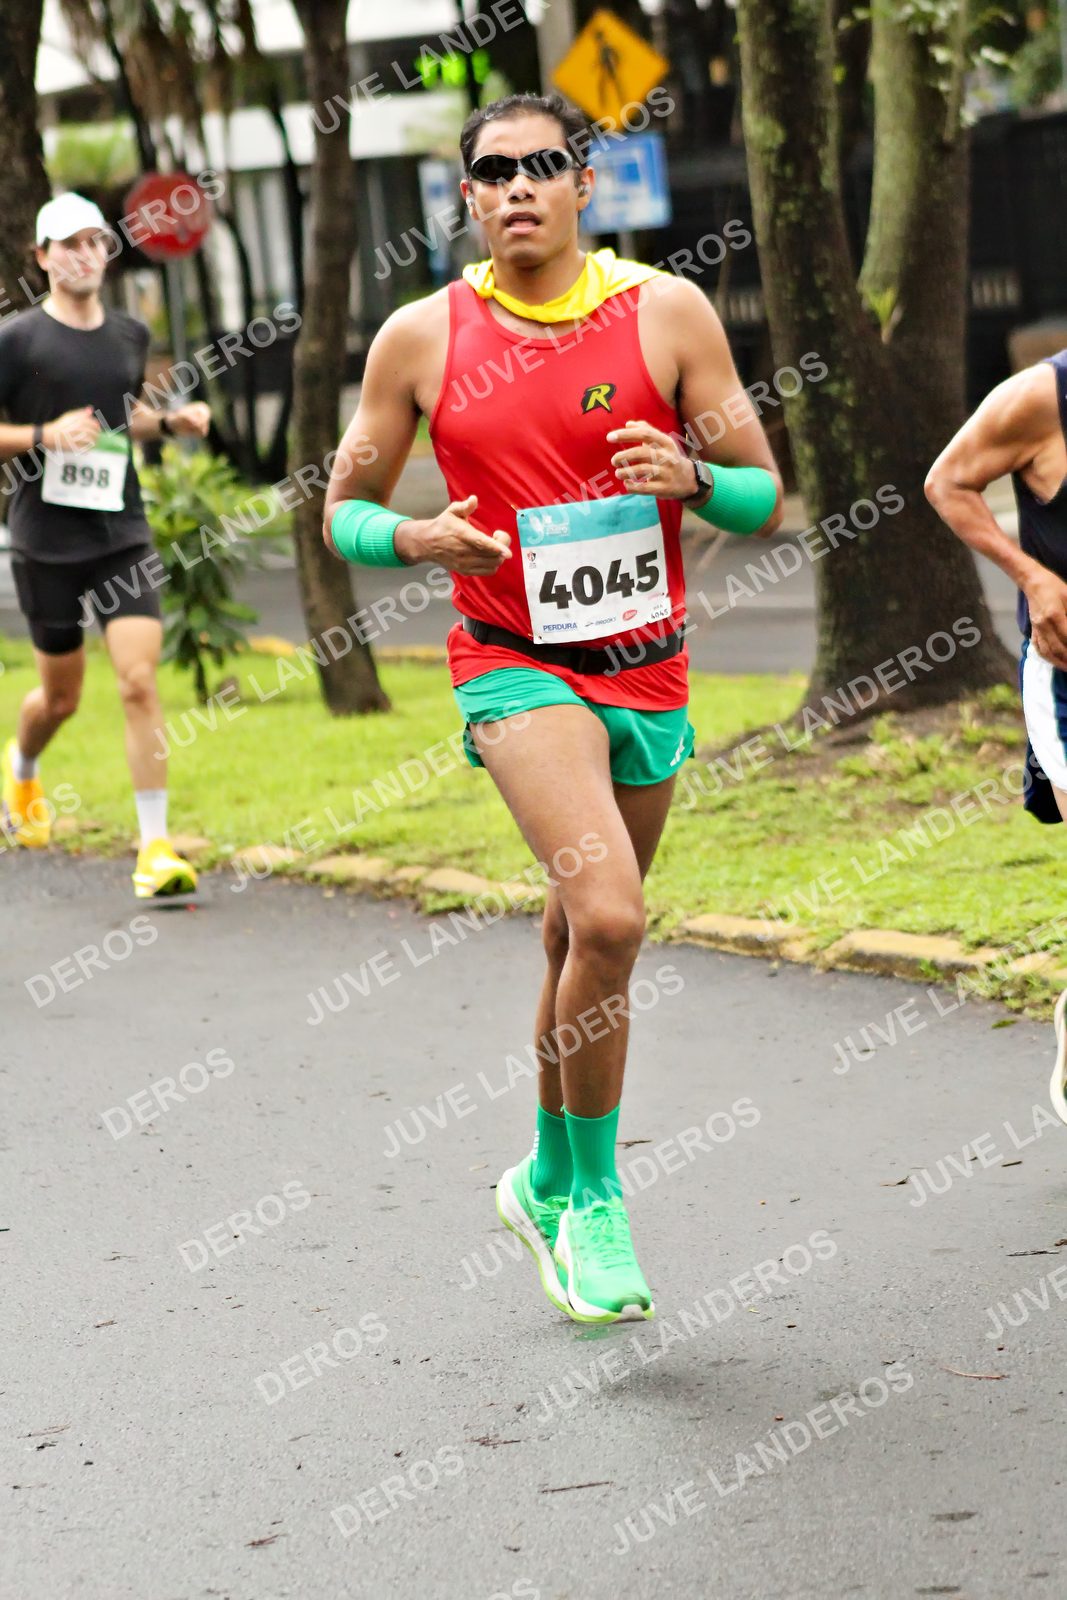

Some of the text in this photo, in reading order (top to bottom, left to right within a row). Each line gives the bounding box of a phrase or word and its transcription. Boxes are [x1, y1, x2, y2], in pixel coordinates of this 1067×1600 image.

[583, 383, 615, 413] R
[61, 463, 110, 488] 898
[539, 550, 660, 609] 4045
[543, 622, 578, 632] PERDURA
